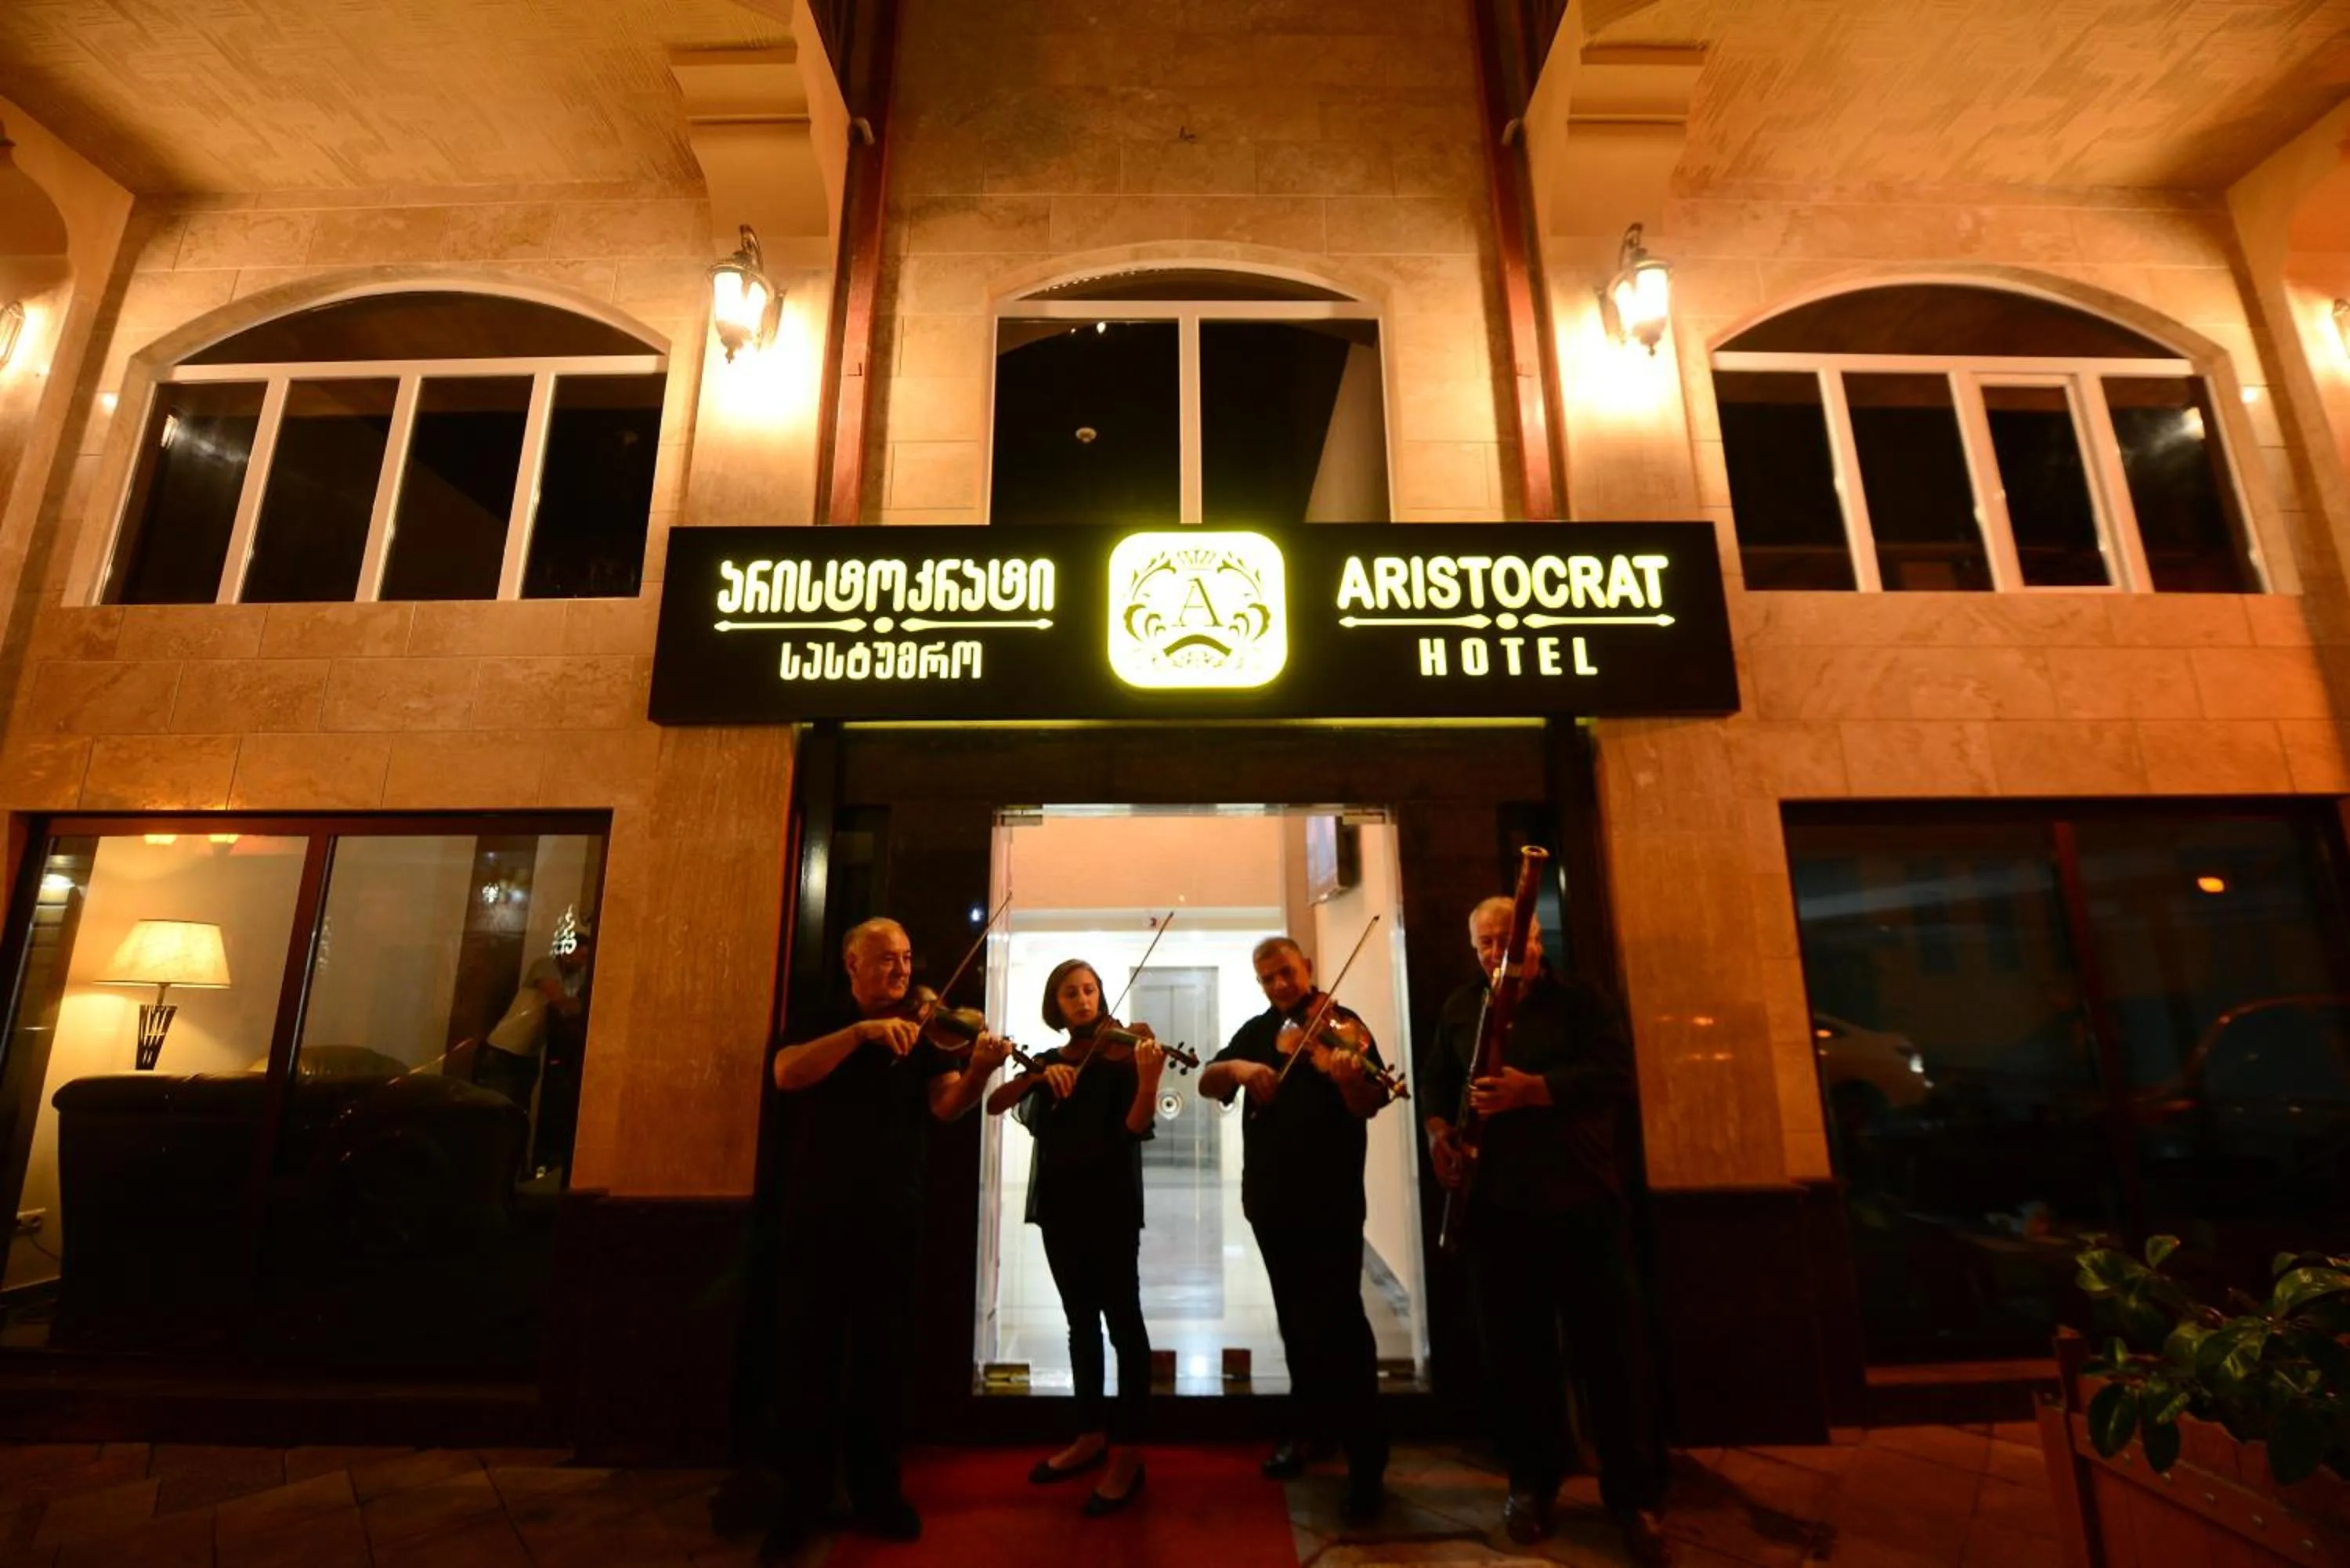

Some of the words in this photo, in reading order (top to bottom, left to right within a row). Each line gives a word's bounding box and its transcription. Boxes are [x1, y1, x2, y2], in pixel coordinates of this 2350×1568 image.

[716, 558, 1057, 614] არისტოკრატი
[1171, 576, 1224, 628] A
[1336, 554, 1669, 610] ARISTOCRAT
[779, 641, 983, 681] სასტუმრო
[1419, 637, 1599, 676] HOTEL
